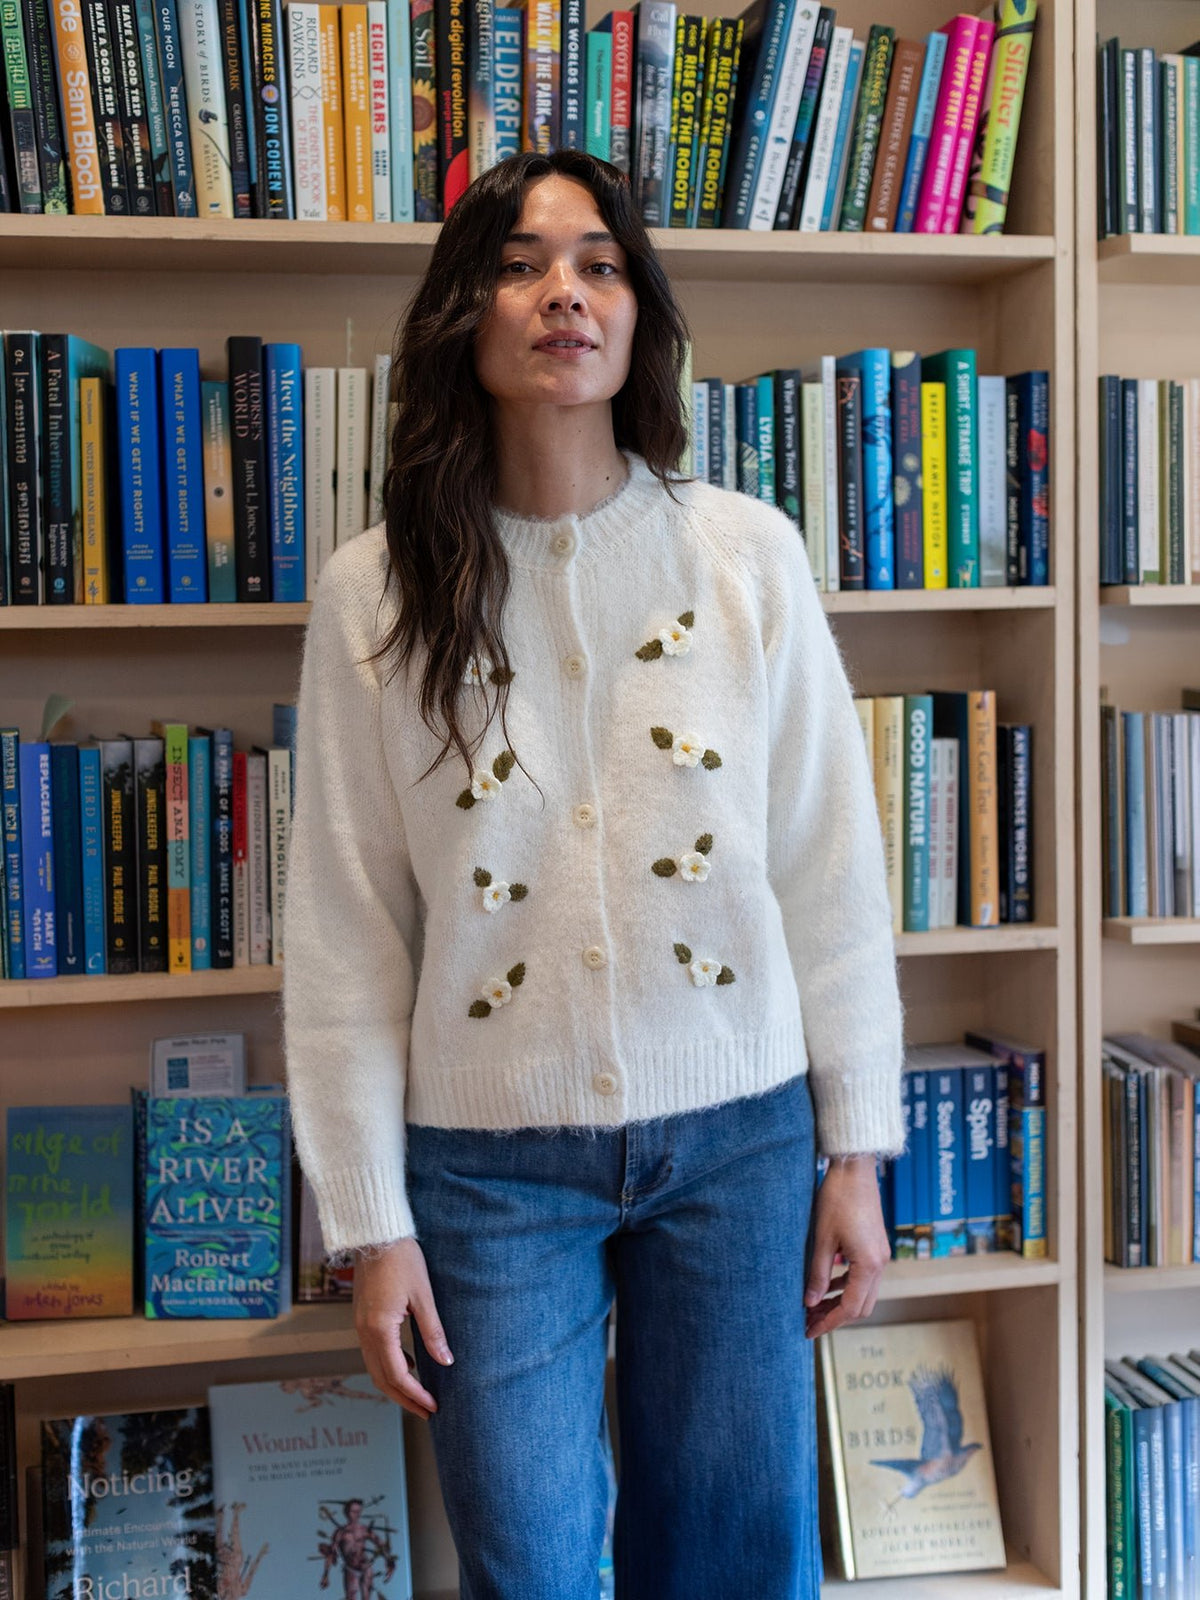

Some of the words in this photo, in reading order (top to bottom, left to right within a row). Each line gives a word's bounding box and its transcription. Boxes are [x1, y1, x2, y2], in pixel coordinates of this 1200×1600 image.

[95, 3, 106, 33] HAVE
[121, 4, 132, 35] HAVE
[161, 8, 172, 31] OUR
[194, 4, 206, 46] STORY
[225, 3, 235, 22] THE
[536, 3, 552, 36] WALK
[567, 0, 579, 24] THE
[98, 37, 107, 47] A
[125, 39, 134, 48] A
[144, 34, 153, 42] A
[164, 35, 175, 69] MOON
[226, 24, 238, 56] WILD
[261, 23, 275, 82] MIRACLES
[292, 11, 305, 79] DAWKINS
[307, 17, 318, 74] RICHARD
[371, 23, 384, 73] EIGHT
[414, 27, 433, 68] Soil
[448, 19, 466, 65] digital
[536, 41, 551, 53] IN
[615, 21, 628, 83] COYOTE
[100, 49, 111, 83] GOOD
[126, 51, 137, 86] GOOD
[146, 43, 157, 79] Woman
[536, 54, 551, 79] THE
[567, 28, 579, 85] WORLDS
[683, 54, 697, 87] RISE
[716, 55, 733, 90] RISE
[870, 35, 890, 106] CROSSINGS
[951, 48, 970, 87] POPPY
[969, 51, 987, 88] POPPY
[199, 64, 211, 103] BIRDS
[228, 59, 240, 90] DARK
[998, 41, 1028, 128] Slither
[67, 71, 87, 126] Sam
[104, 86, 115, 115] TRIP
[131, 88, 141, 117] TRIP
[148, 81, 160, 112] Among
[169, 86, 182, 137] REBECCA
[373, 79, 386, 134] BEARS
[443, 90, 452, 121] george
[452, 68, 465, 137] revolution
[536, 83, 552, 116] PARK
[567, 98, 578, 120] SEE
[681, 91, 696, 115] OF
[714, 92, 729, 116] OF
[944, 90, 962, 128] STATE
[961, 94, 980, 132] STATE
[152, 115, 164, 148] Wolves
[232, 104, 241, 130] CRAIG
[264, 106, 278, 134] JON
[297, 119, 306, 132] OF
[309, 105, 318, 124] THE
[613, 88, 628, 162] AMERICA
[678, 118, 694, 145] THE
[709, 118, 726, 145] THE
[865, 113, 878, 141] BEN
[105, 122, 117, 161] EUGENIA
[131, 123, 143, 163] EUGENIA
[234, 131, 245, 163] CHILDS
[297, 137, 307, 155] THE
[309, 126, 320, 169] GENETIC
[444, 123, 453, 159] eastman
[73, 131, 99, 200] Bloch
[175, 141, 186, 176] BOYLE
[266, 139, 282, 191] COHEN
[298, 159, 308, 188] DEAD
[854, 142, 875, 209] GOLDFARB
[109, 164, 119, 188] BONE
[136, 165, 145, 189] BONE
[311, 173, 321, 204] BOOK
[673, 149, 691, 211] ROBOTS
[702, 149, 722, 211] ROBOTS
[48, 350, 58, 361] A
[48, 368, 62, 407] Fatal
[129, 372, 140, 408] WHAT
[174, 372, 185, 408] WHAT
[279, 369, 295, 415] Meet
[784, 379, 796, 413] When
[956, 373, 971, 413] SHORT,
[131, 411, 140, 421] IF
[175, 411, 184, 421] IF
[234, 372, 249, 438] WORLD
[929, 393, 938, 439] BREATH
[131, 426, 141, 444] WE
[176, 426, 185, 444] WE
[281, 419, 297, 449] the
[758, 416, 771, 462] LYDIA
[785, 416, 797, 449] Trees
[957, 415, 971, 465] STRANGE
[49, 414, 64, 507] Inheritance
[131, 448, 142, 472] GET
[176, 448, 187, 472] GET
[784, 452, 797, 489] Testify
[930, 456, 939, 496] JAMES
[133, 475, 143, 486] IT
[177, 475, 187, 486] IT
[957, 470, 972, 495] TRIP
[133, 489, 144, 533] RIGHT?
[178, 489, 188, 532] RIGHT?
[280, 453, 298, 544] Neighbors
[931, 501, 940, 549] NESTOR
[49, 524, 59, 566] Ingrassia
[59, 523, 68, 567] Lawrence
[219, 744, 228, 756] IN
[910, 709, 926, 768] GOOD
[977, 721, 990, 745] The
[1013, 730, 1027, 750] AN
[171, 746, 183, 804] INSECT
[219, 760, 229, 795] PRAISE
[979, 751, 991, 783] God
[40, 754, 51, 838] REPLACEABLE
[84, 765, 95, 818] THIRD
[219, 797, 229, 811] OF
[979, 788, 992, 815] Test
[1013, 752, 1028, 824] IMMENSE
[111, 789, 123, 852] JUNGLEKEEPER
[146, 789, 158, 850] JUNGLEKEEPER
[910, 772, 926, 846] NATURE
[86, 826, 97, 857] EAR
[174, 807, 184, 879] ANATOMY
[219, 814, 230, 854] FLOODS
[276, 809, 285, 886] ENTANGLED
[1014, 830, 1028, 884] WORLD
[113, 866, 124, 887] PAUL
[148, 865, 159, 886] PAUL
[219, 862, 230, 894] JAMES
[113, 889, 124, 924] ROSOLIE
[148, 888, 159, 922] ROSOLIE
[45, 912, 54, 945] MARY
[220, 908, 230, 941] SCOTT
[180, 1116, 212, 1143] IS
[226, 1117, 248, 1142] A
[937, 1100, 955, 1149] South
[966, 1098, 994, 1161] Spain
[995, 1096, 1009, 1149] Vietnam
[158, 1156, 269, 1184] RIVER
[938, 1150, 957, 1216] America
[150, 1196, 276, 1225] ALIVE?
[174, 1248, 251, 1268] Robert
[151, 1273, 275, 1293] Macfarlane
[846, 1369, 906, 1391] BOOK
[242, 1426, 318, 1454] Wound
[322, 1426, 369, 1449] Man
[848, 1427, 917, 1449] BIRDS
[66, 1467, 194, 1502] Noticing
[76, 1566, 192, 1600] Richard
